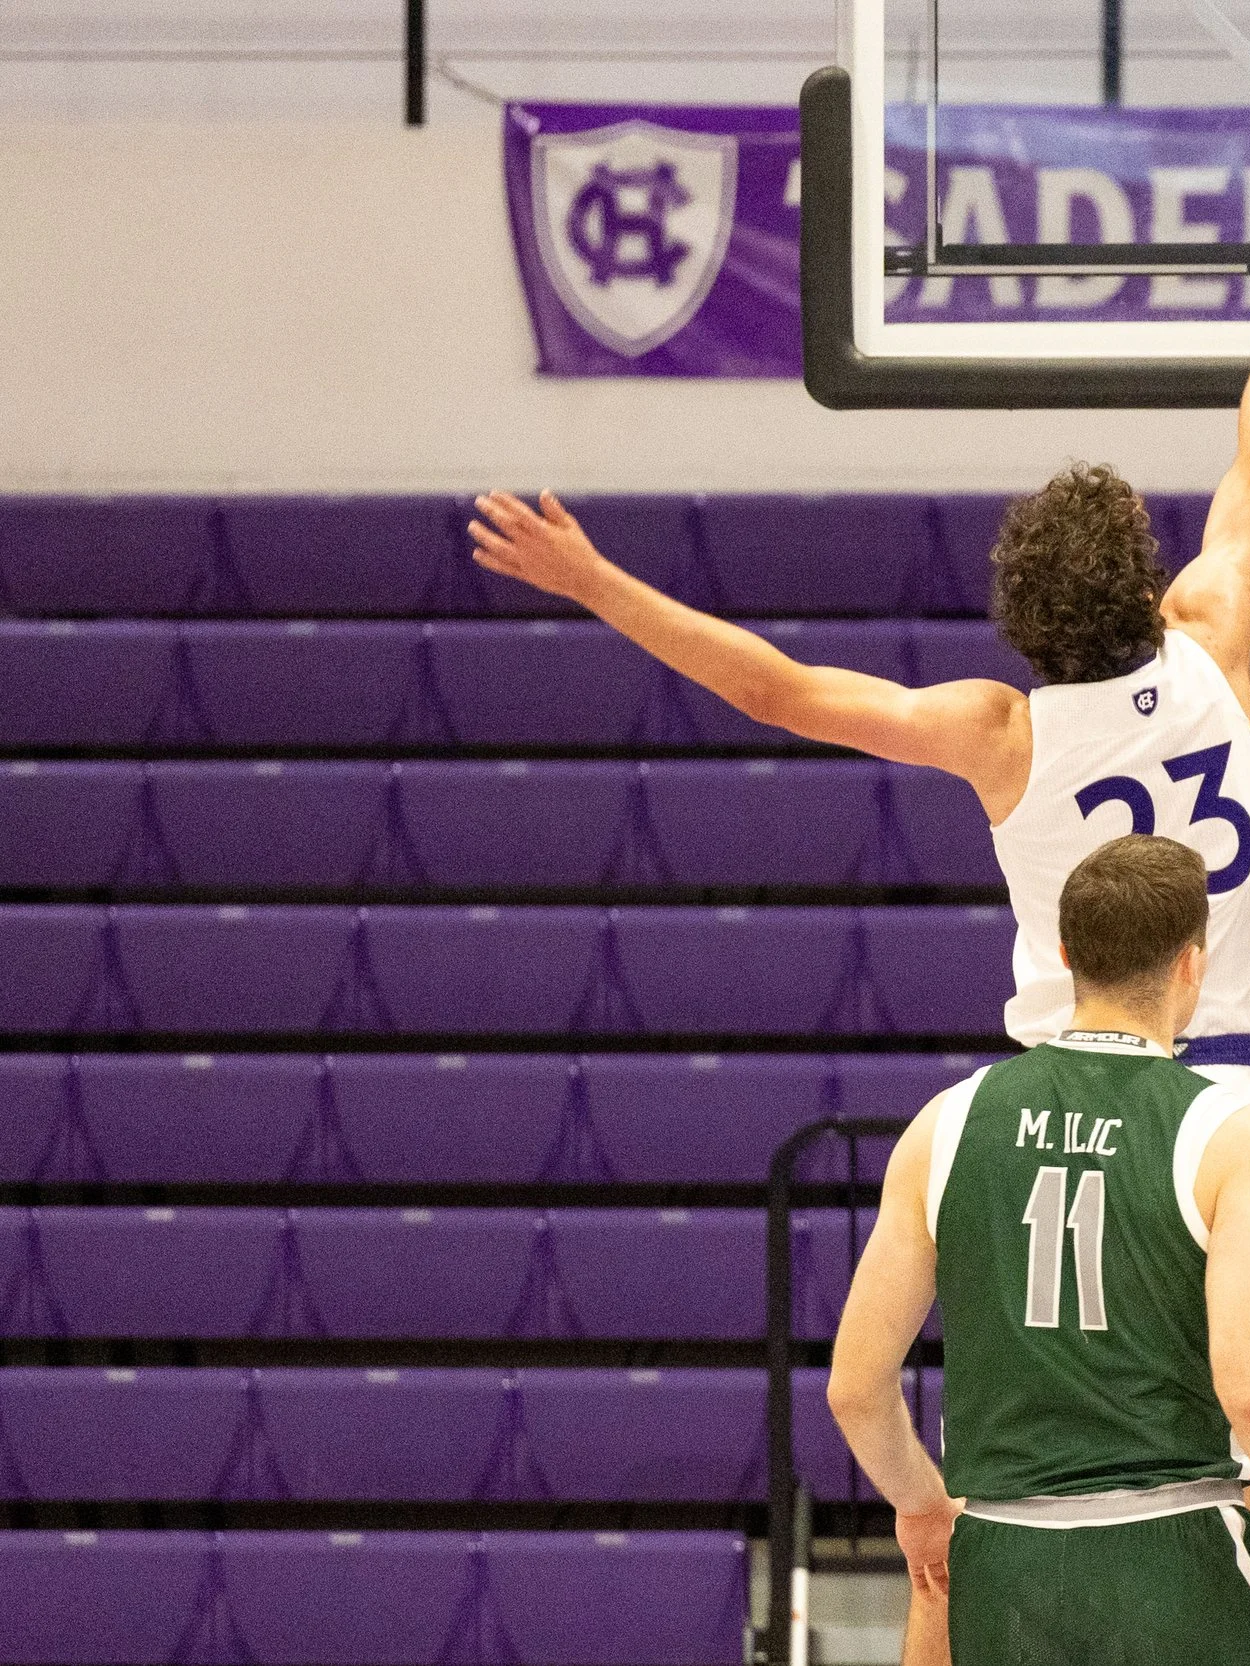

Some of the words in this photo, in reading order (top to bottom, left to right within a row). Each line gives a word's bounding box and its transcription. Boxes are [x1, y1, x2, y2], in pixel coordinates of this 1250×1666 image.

[1066, 1031, 1141, 1046] ARMOUR
[1015, 1108, 1054, 1149] M.
[1063, 1112, 1123, 1157] ILIC
[1021, 1165, 1109, 1331] 11
